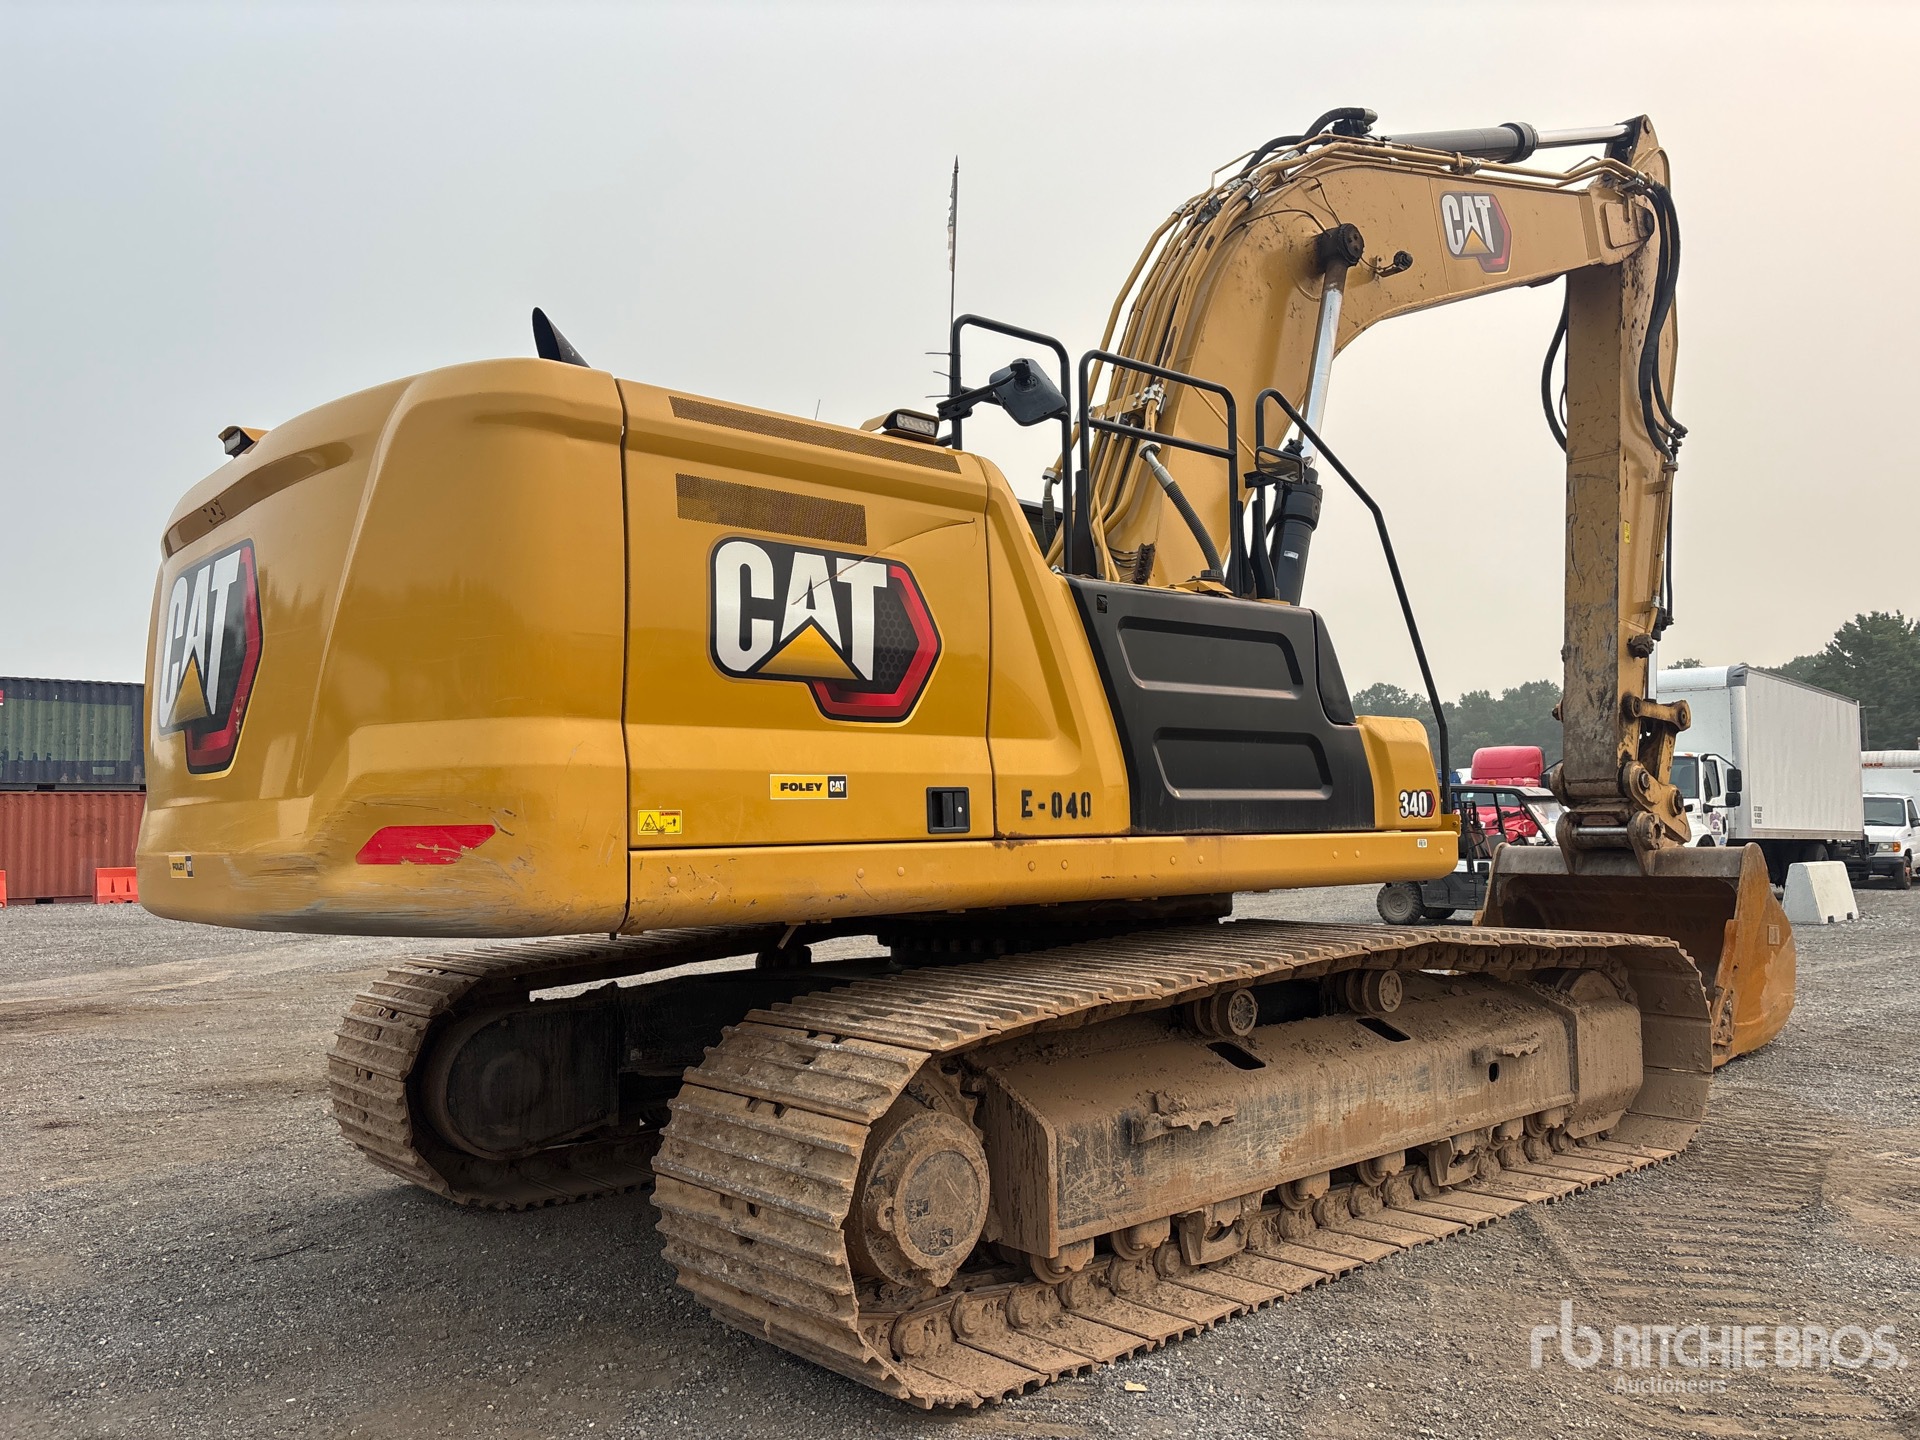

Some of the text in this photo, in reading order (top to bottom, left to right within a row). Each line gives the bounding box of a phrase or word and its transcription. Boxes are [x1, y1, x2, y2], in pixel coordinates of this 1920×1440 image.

[1441, 194, 1495, 255] CAT
[715, 541, 888, 681] CAT
[159, 549, 241, 728] CAT
[780, 780, 845, 792] FOLEY CAT
[1021, 789, 1091, 819] E-040
[1399, 791, 1428, 817] 340
